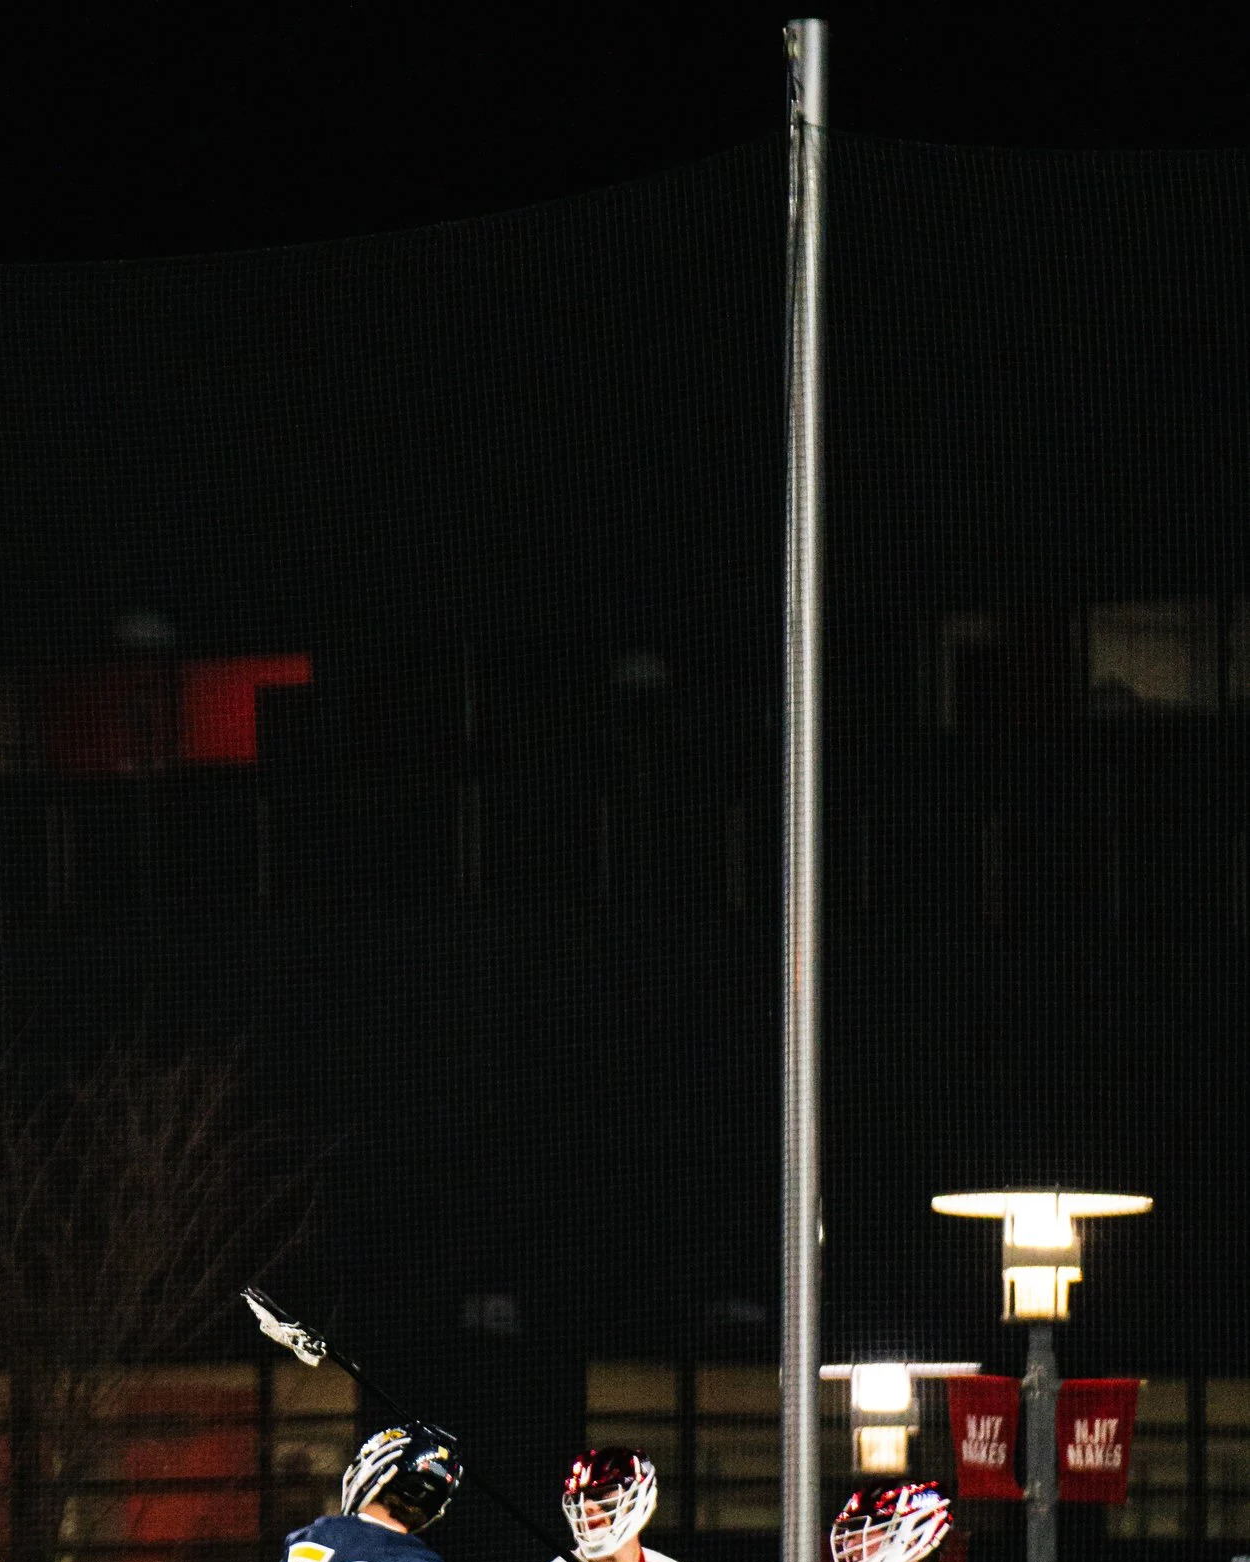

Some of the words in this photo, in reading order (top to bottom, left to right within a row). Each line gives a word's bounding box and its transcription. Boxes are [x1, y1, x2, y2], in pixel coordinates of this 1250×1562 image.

[966, 1414, 1003, 1441] NJIT
[1073, 1418, 1119, 1444] NJIT
[961, 1439, 1007, 1465] MAKES
[1066, 1443, 1123, 1469] MAKES
